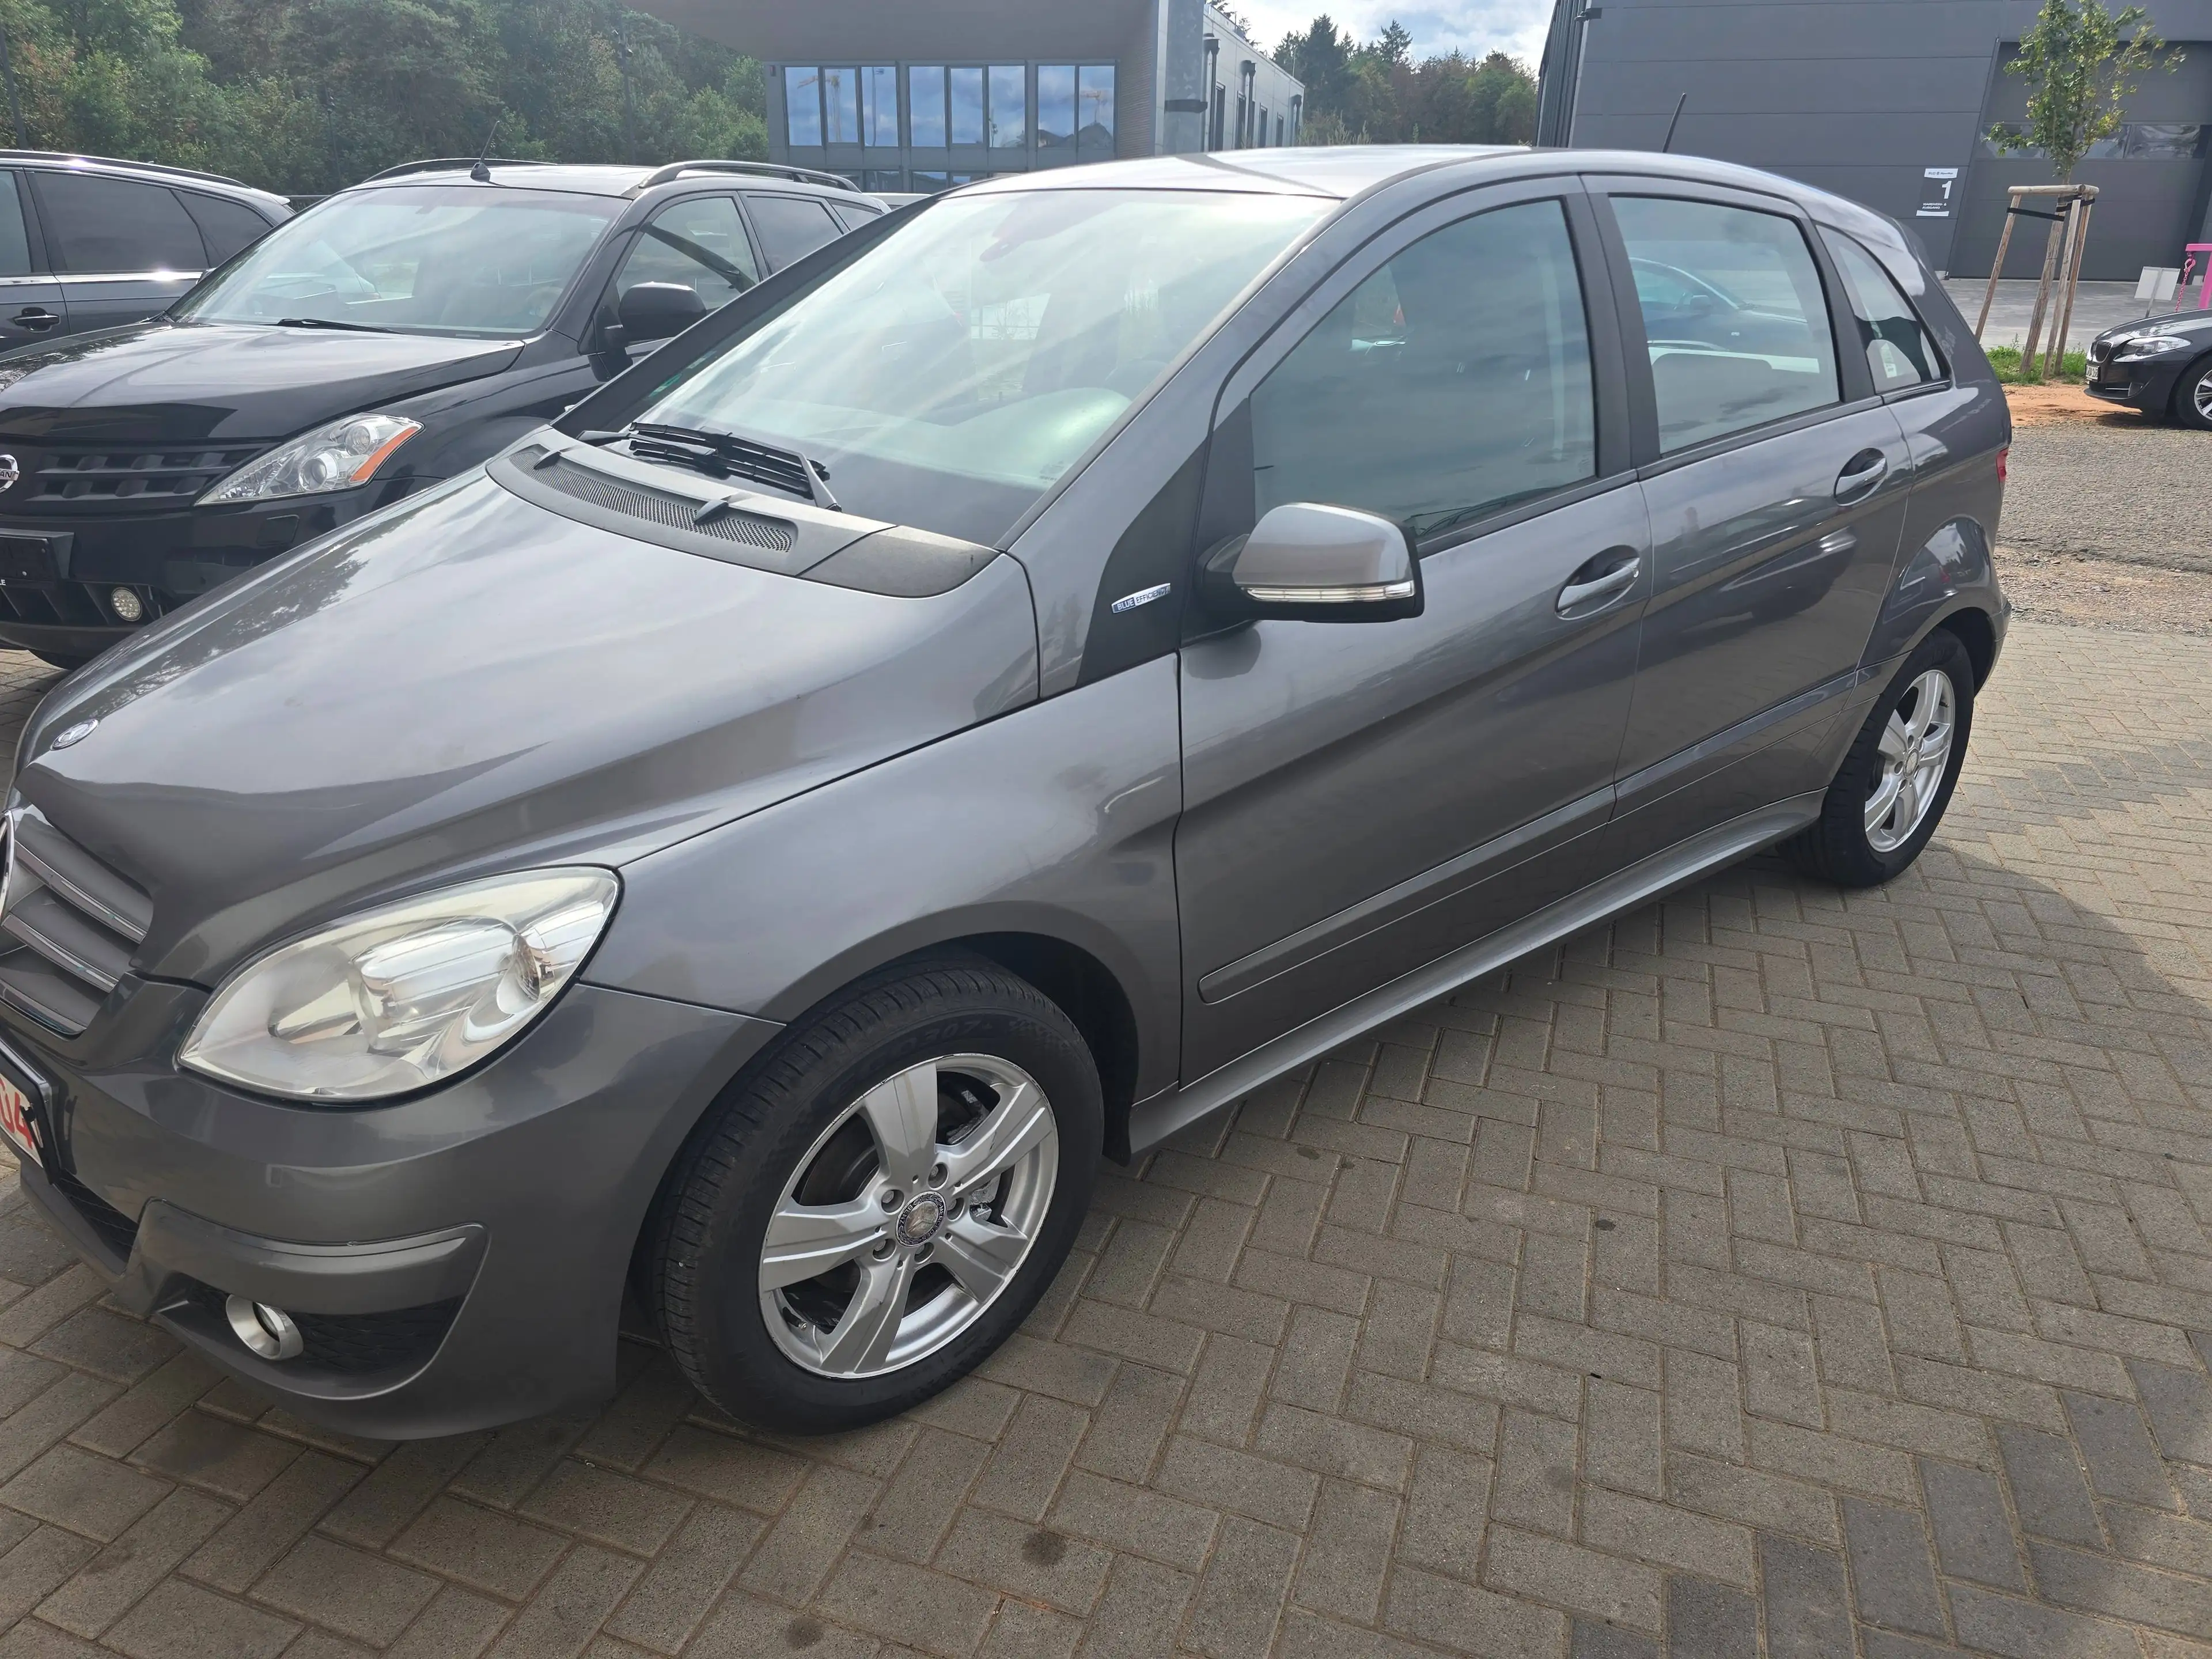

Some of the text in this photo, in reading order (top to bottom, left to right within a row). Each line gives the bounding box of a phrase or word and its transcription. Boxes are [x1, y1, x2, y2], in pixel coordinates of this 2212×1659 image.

[1942, 180, 1952, 199] 1
[1117, 598, 1134, 611] BLUE
[899, 1204, 914, 1225] BENZ
[921, 1204, 944, 1240] MERCEDES
